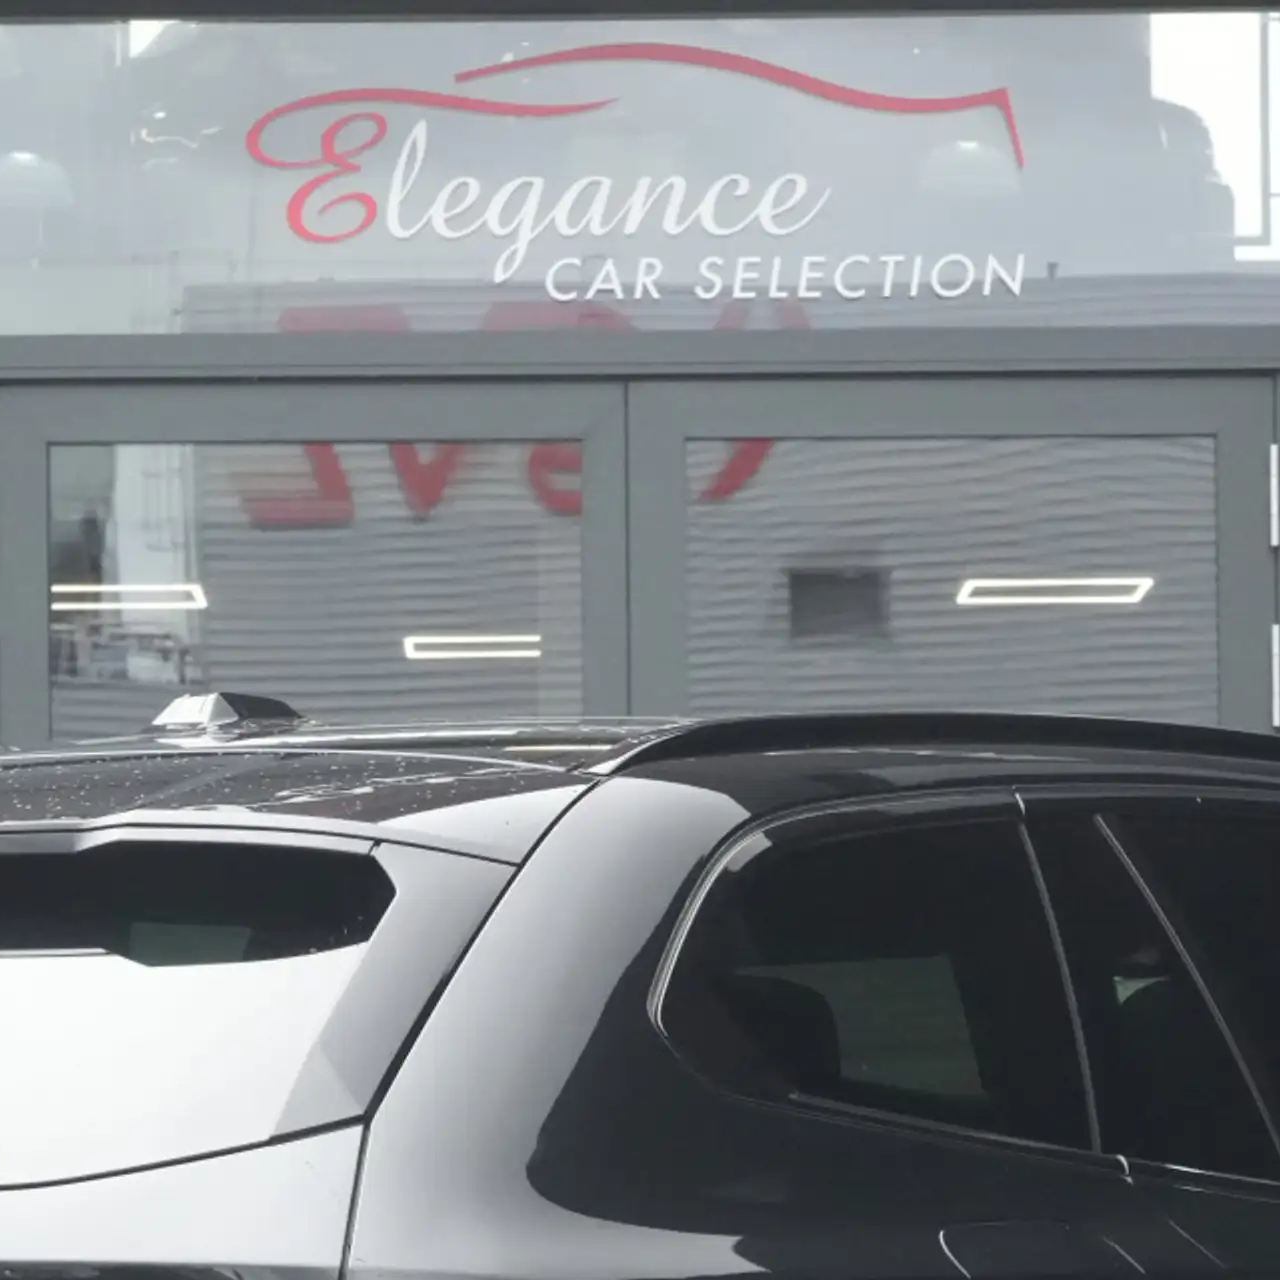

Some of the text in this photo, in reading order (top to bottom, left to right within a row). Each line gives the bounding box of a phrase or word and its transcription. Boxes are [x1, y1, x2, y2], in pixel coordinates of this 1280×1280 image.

[247, 90, 832, 284] Elegance
[544, 252, 1026, 302] CAR SELECTION
